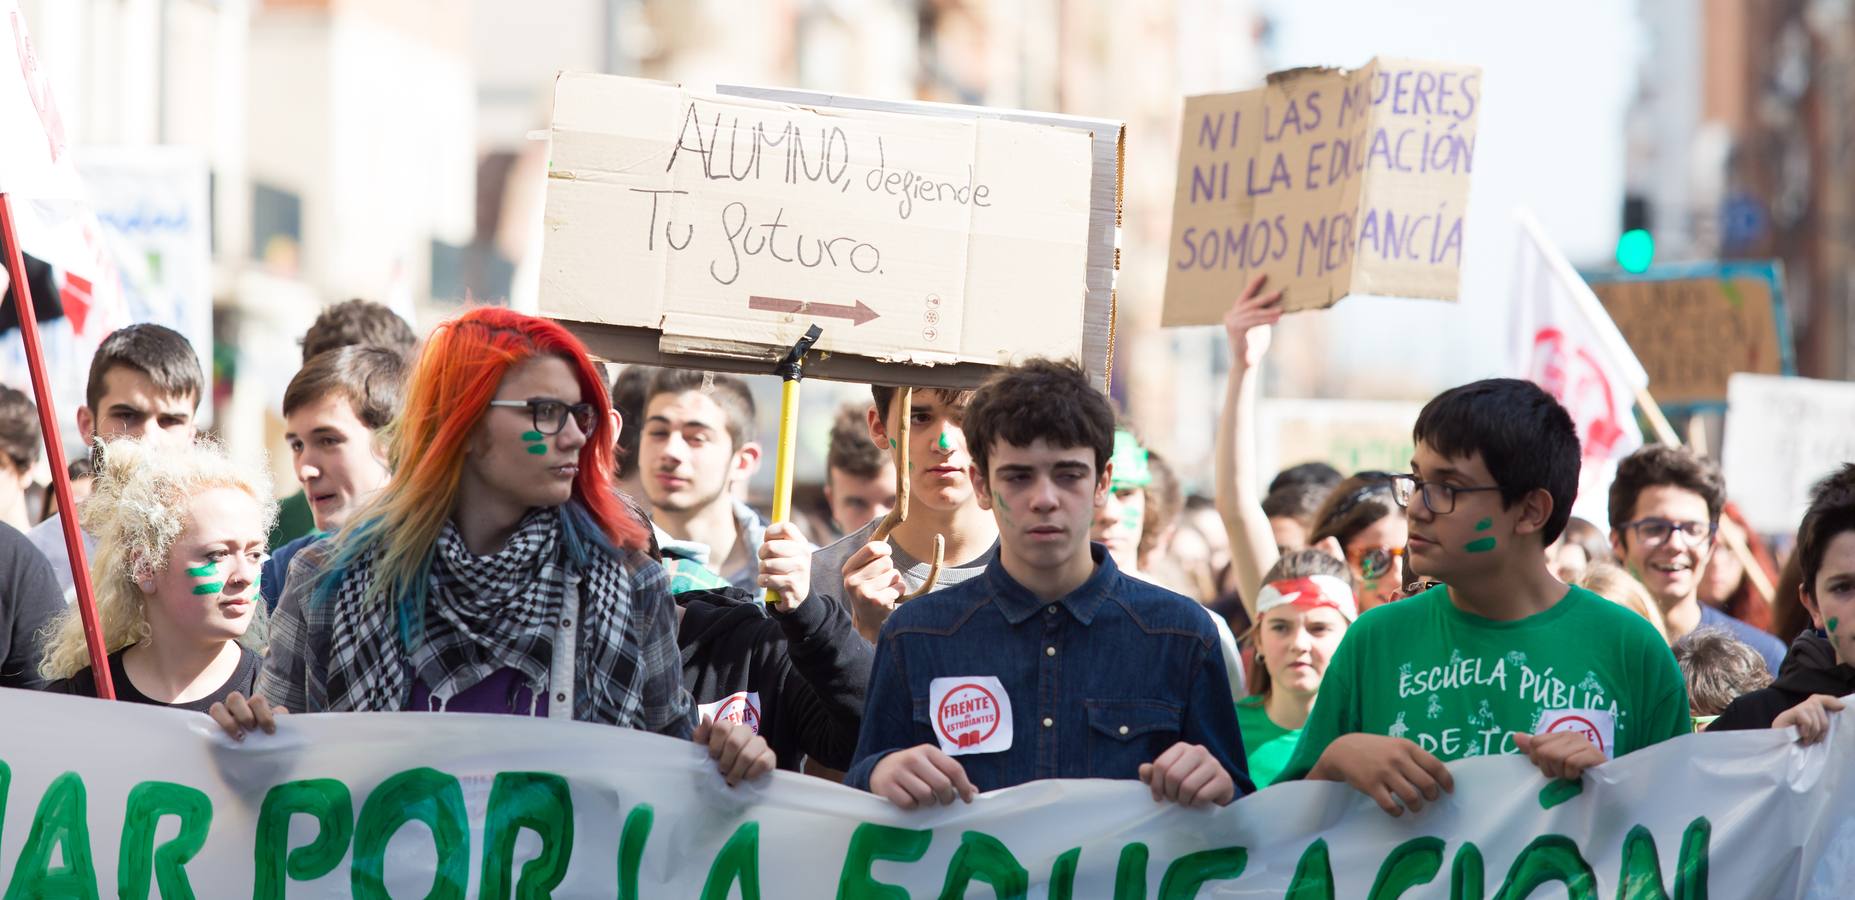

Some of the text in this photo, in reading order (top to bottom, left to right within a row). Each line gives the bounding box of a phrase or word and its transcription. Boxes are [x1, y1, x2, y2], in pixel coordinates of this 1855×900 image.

[1199, 111, 1240, 151] NI
[1263, 90, 1322, 143] LAS
[666, 101, 992, 220] ALUMNO, defiende
[1190, 161, 1229, 204] NI
[1246, 152, 1293, 197] LA
[629, 188, 884, 286] Tu futuro.
[1176, 213, 1289, 272] SOMOS
[1398, 657, 1507, 699] ESCUELA
[944, 697, 990, 719] FRENTE
[946, 714, 995, 732] ESTUDIANTES
[1417, 728, 1461, 756] DE
[0, 758, 212, 900] AR
[252, 766, 575, 900] POR
